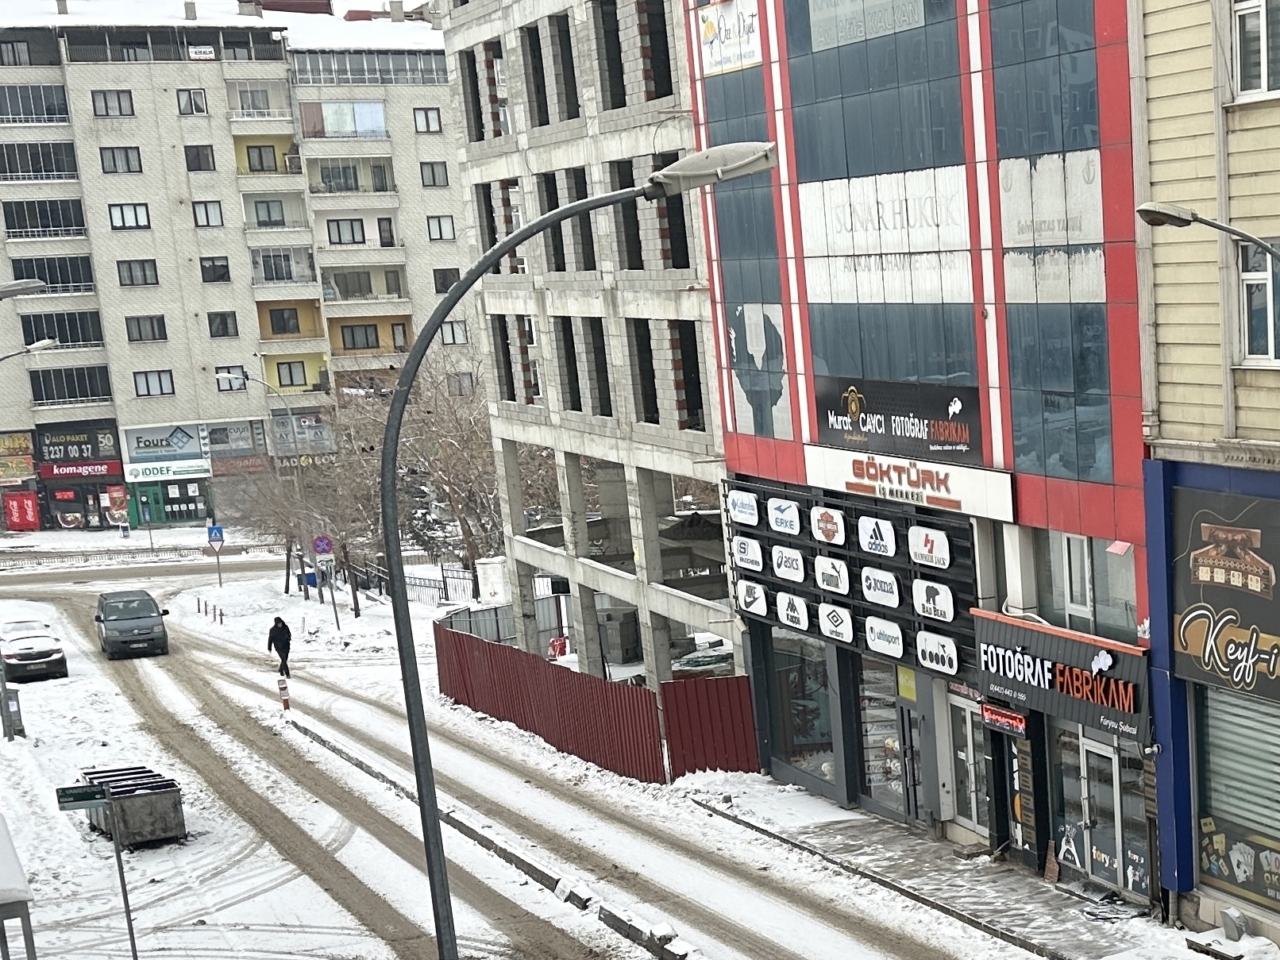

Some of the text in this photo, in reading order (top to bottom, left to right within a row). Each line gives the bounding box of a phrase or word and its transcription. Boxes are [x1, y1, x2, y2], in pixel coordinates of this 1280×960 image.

[867, 3, 920, 34] KALKAN
[892, 195, 962, 230] HUKUK
[828, 410, 853, 431] Murat
[891, 413, 929, 441] FOTOĞRAF
[53, 465, 108, 476] komagene
[852, 455, 951, 495] GÖKTÜRK
[774, 517, 796, 530] ERKE
[867, 541, 889, 554] adidas
[783, 556, 800, 571] asics
[876, 629, 901, 647] uhlsport
[1180, 610, 1278, 684] Keyf-i
[980, 643, 1053, 690] FOTOĞRAF
